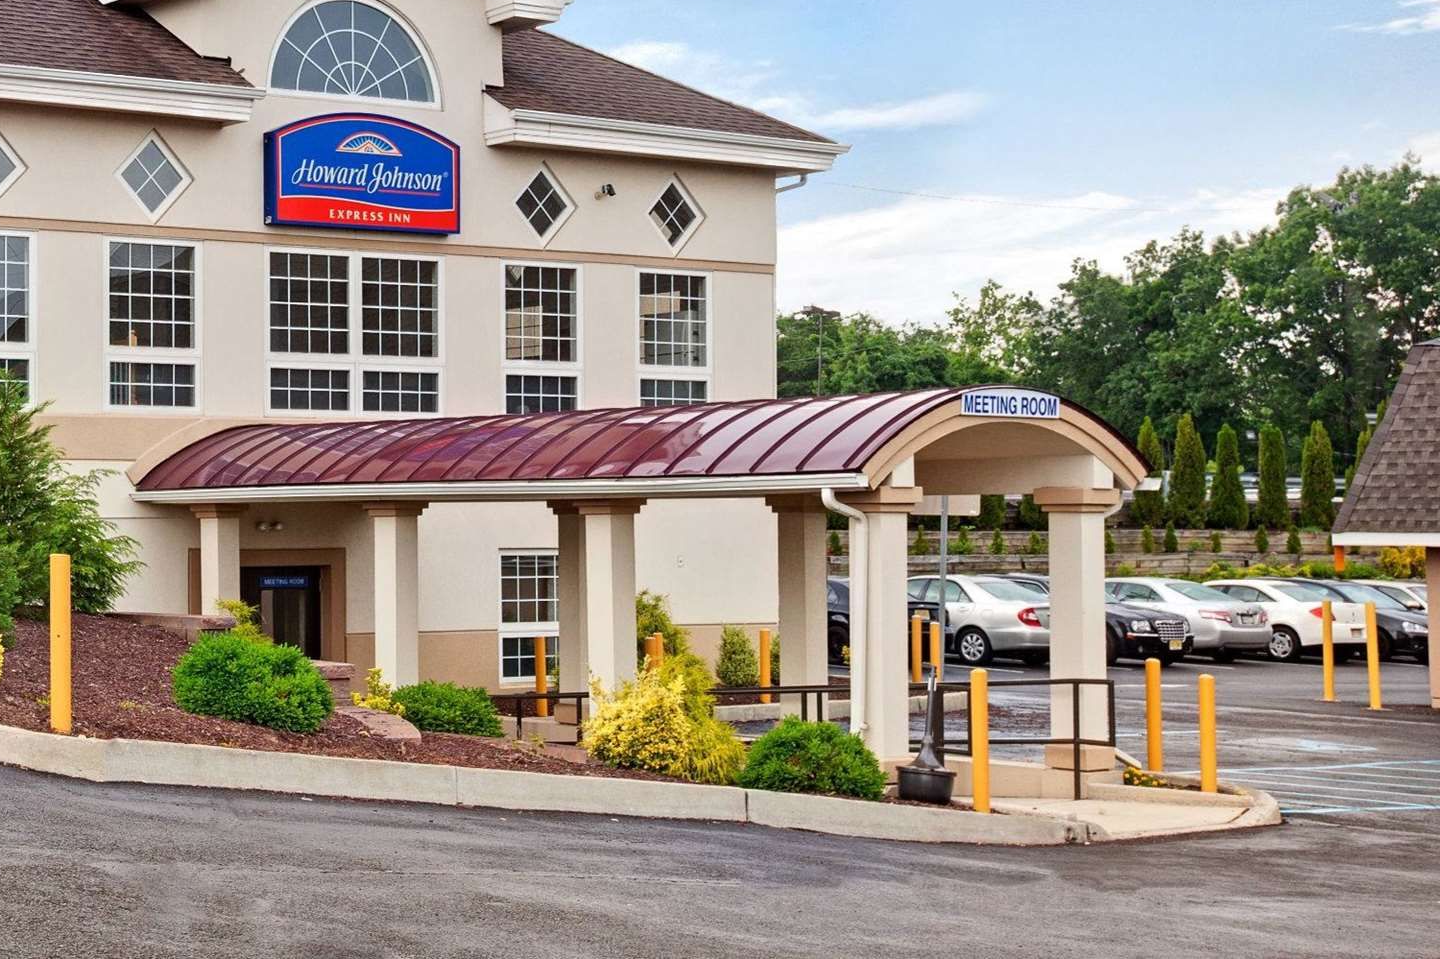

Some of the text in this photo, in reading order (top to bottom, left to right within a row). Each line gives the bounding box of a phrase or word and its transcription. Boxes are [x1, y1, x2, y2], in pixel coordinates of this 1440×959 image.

[291, 159, 442, 194] Howard Johnson
[329, 209, 411, 223] EXPRESS INN
[964, 394, 1057, 416] MEETING ROOM
